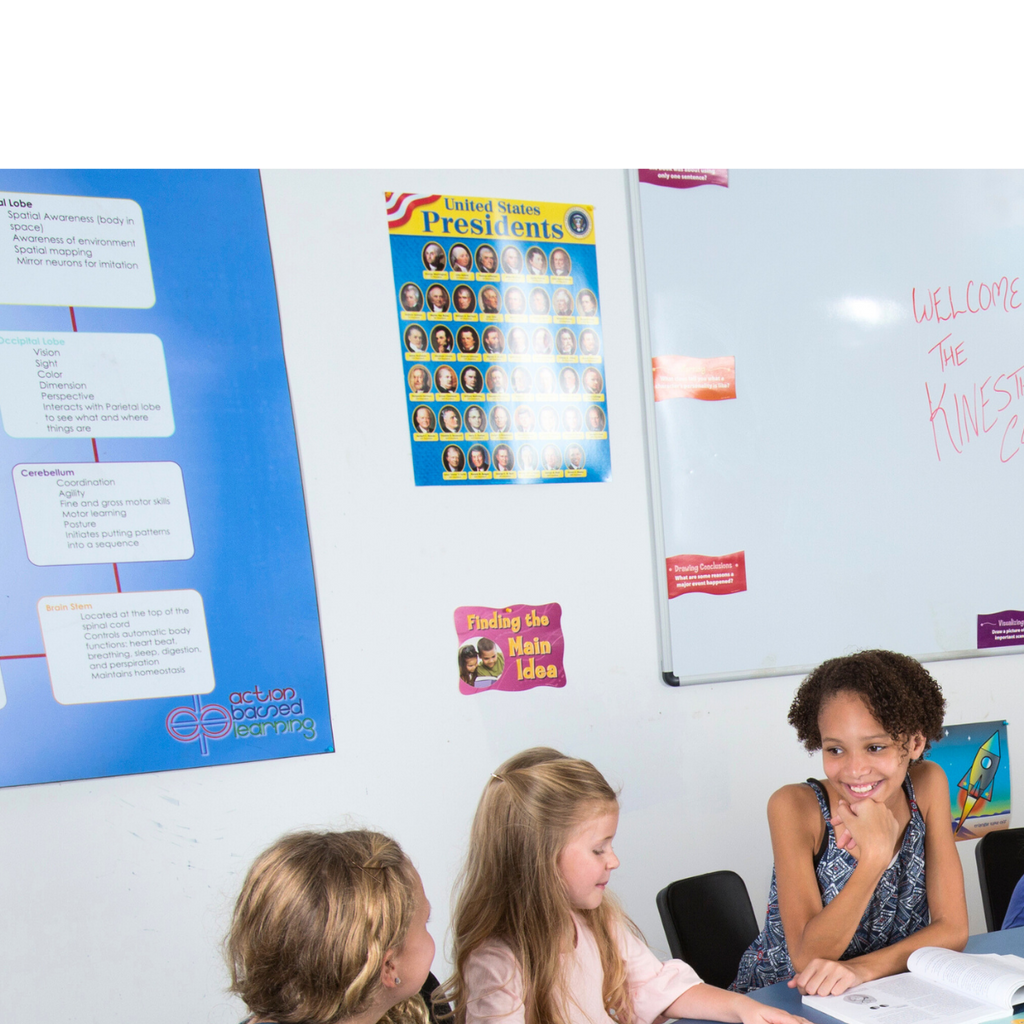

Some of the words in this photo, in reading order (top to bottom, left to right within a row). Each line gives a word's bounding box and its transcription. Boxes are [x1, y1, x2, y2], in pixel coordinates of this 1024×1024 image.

[8, 199, 32, 208] Lobe
[444, 198, 494, 212] United
[498, 201, 541, 216] States
[8, 210, 41, 220] Spatial
[44, 213, 94, 223] Awareness
[97, 215, 124, 226] (body
[126, 217, 134, 225] in
[10, 223, 44, 234] space)
[421, 210, 564, 239] Presidents
[13, 234, 64, 244] Awareness
[66, 236, 75, 244] of
[78, 237, 136, 248] environment
[14, 245, 47, 255] Spatial
[50, 248, 92, 258] mapping
[17, 257, 42, 266] Mirror
[84, 260, 96, 268] for
[99, 261, 138, 270] imitation
[912, 276, 1022, 324] WELCOME
[42, 338, 65, 346] Lobe
[33, 348, 60, 356] Vision
[928, 333, 968, 372] THE
[36, 360, 58, 369] Sight
[38, 370, 62, 378] Color
[40, 381, 87, 390] Dimension
[41, 392, 94, 402] Perspective
[43, 403, 83, 411] Interacts
[86, 403, 104, 411] with
[106, 403, 139, 411] Parietal
[47, 424, 74, 434] things
[21, 469, 74, 477] Cerebellum
[59, 490, 85, 498] Agility
[102, 500, 124, 508] gross
[153, 498, 170, 506] skills
[91, 510, 126, 518] learning
[102, 530, 132, 538] putting
[135, 529, 170, 538] patterns
[96, 540, 139, 549] sequence
[674, 565, 698, 573] Drawing
[700, 562, 732, 570] Conclusions
[70, 602, 92, 610] Stem
[81, 612, 118, 620] Located
[132, 610, 146, 618] the
[148, 609, 162, 618] top
[165, 608, 174, 616] of
[176, 608, 189, 616] the
[82, 622, 108, 630] spinal
[467, 611, 520, 632] Finding
[525, 609, 550, 627] the
[84, 632, 120, 640] Controls
[122, 628, 166, 638] automatic
[168, 627, 191, 636] body
[86, 641, 128, 650] functions:
[130, 639, 152, 648] heart
[154, 637, 178, 646] beat,
[508, 636, 551, 656] Main
[88, 650, 132, 660] breathing,
[134, 648, 160, 658] sleep,
[162, 646, 202, 656] digestion,
[90, 662, 108, 670] and
[110, 658, 160, 670] perspiration
[516, 658, 558, 680] Idea
[92, 670, 132, 680] Maintains
[134, 666, 186, 676] homeostasis
[229, 685, 296, 705] action
